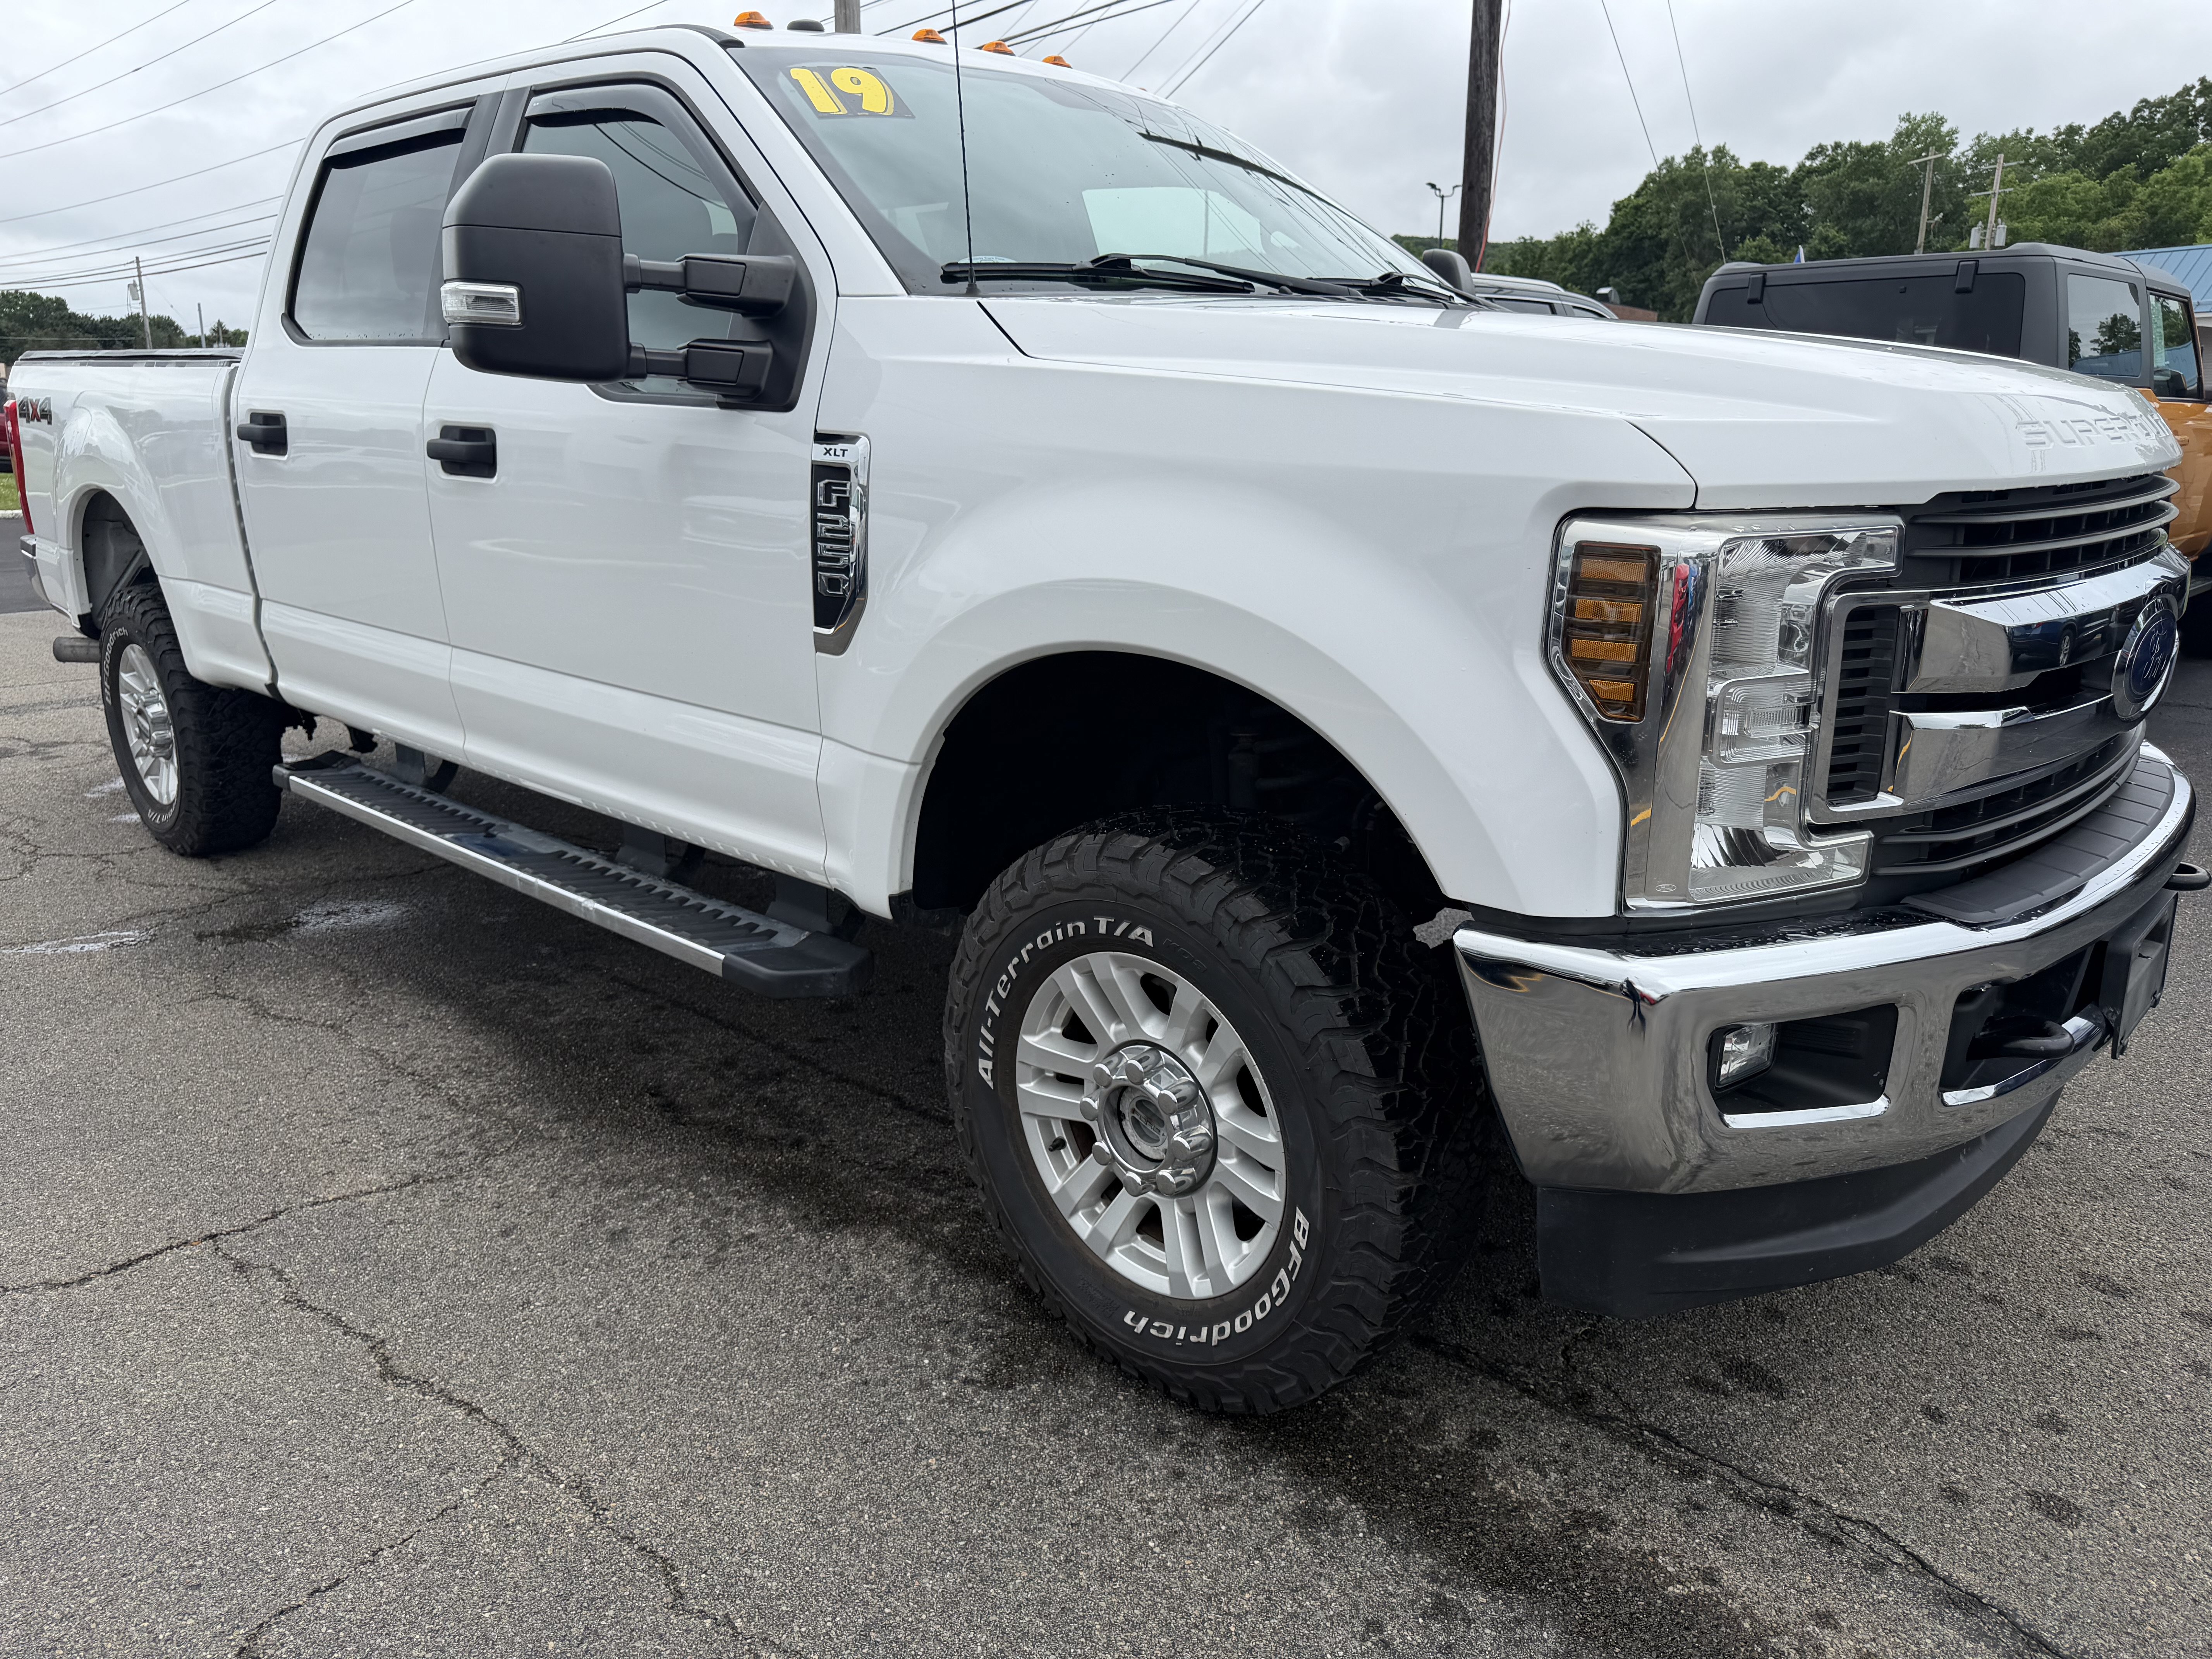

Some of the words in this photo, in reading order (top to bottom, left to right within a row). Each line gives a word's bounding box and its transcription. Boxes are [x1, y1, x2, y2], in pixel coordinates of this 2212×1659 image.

[790, 68, 894, 115] 19
[823, 447, 848, 458] XLT
[2015, 416, 2140, 450] SUPER
[103, 626, 129, 706] BFGoodrich
[978, 921, 1085, 1090] All-Terrain
[1093, 915, 1153, 947] T/A
[1123, 1206, 1309, 1346] BFGoodrich
